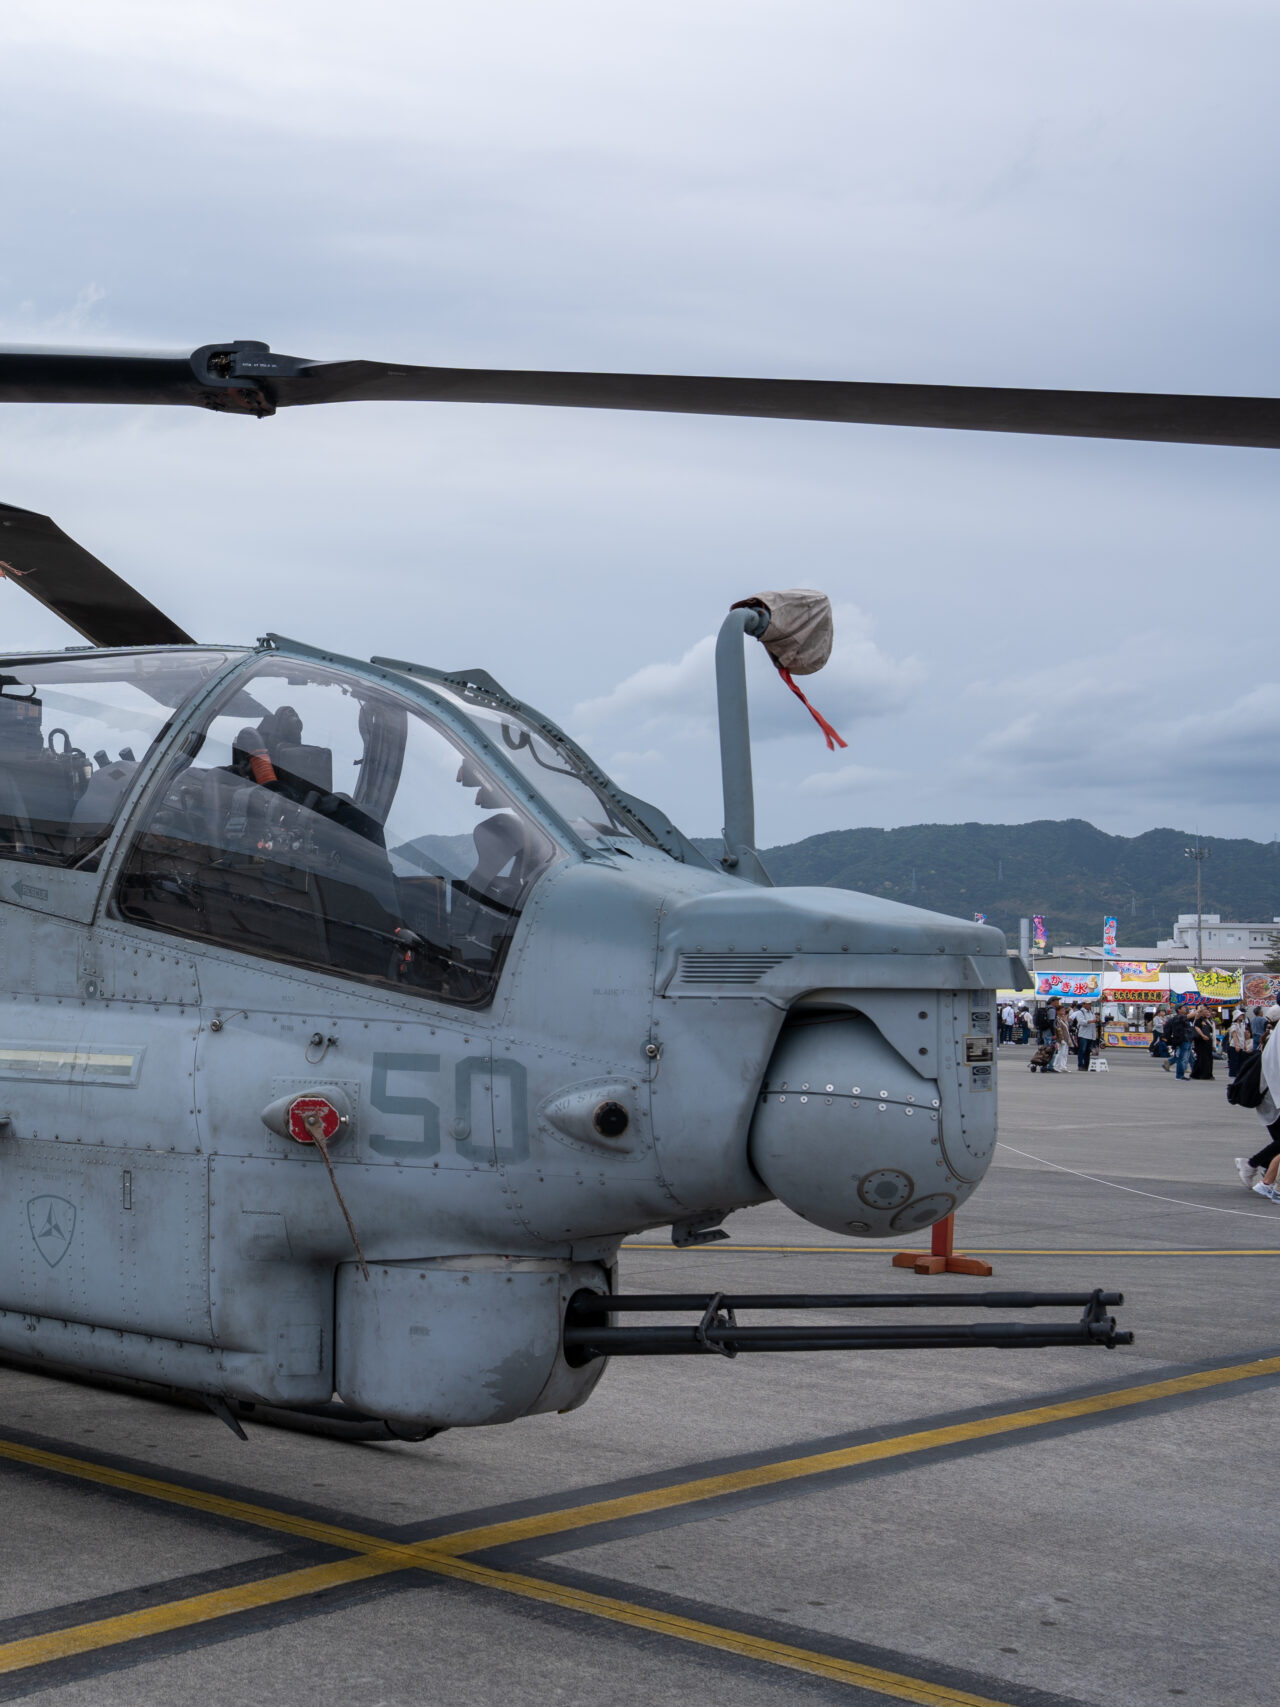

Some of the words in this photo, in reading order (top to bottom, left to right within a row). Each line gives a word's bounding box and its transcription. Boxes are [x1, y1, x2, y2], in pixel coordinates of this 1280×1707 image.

[1051, 974, 1089, 995] かき氷
[370, 1052, 529, 1163] 50
[554, 1099, 570, 1113] NO
